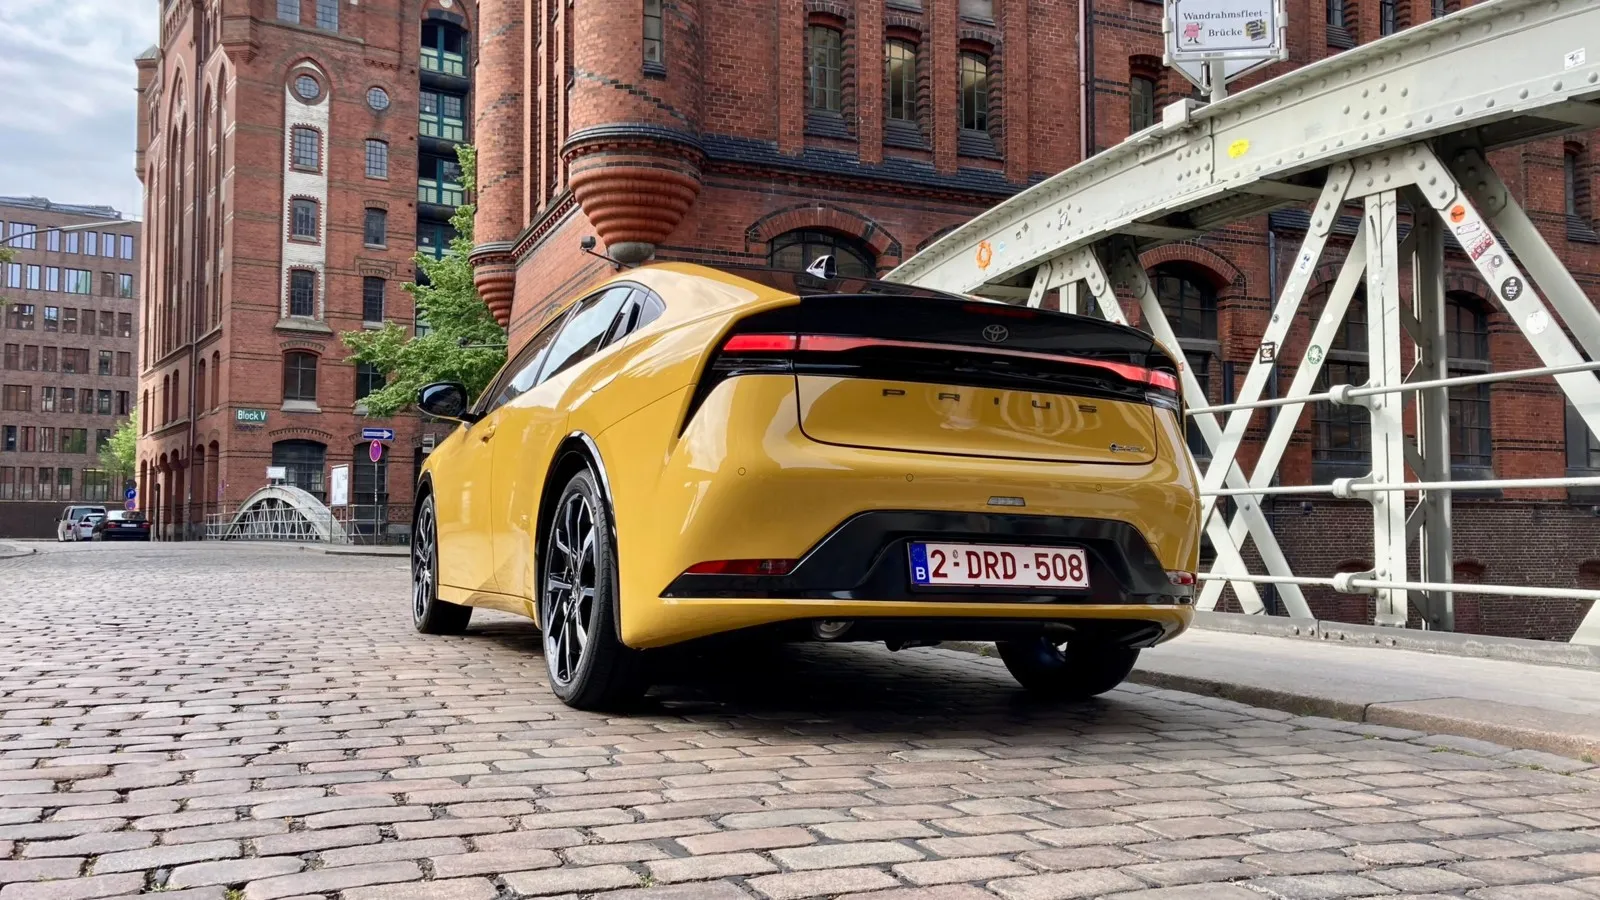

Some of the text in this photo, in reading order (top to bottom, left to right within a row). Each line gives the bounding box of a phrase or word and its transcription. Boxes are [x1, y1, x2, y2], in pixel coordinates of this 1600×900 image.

[1208, 28, 1243, 37] Brücke
[882, 389, 1097, 413] PRIUS
[237, 410, 266, 421] Block V
[915, 566, 926, 580] B
